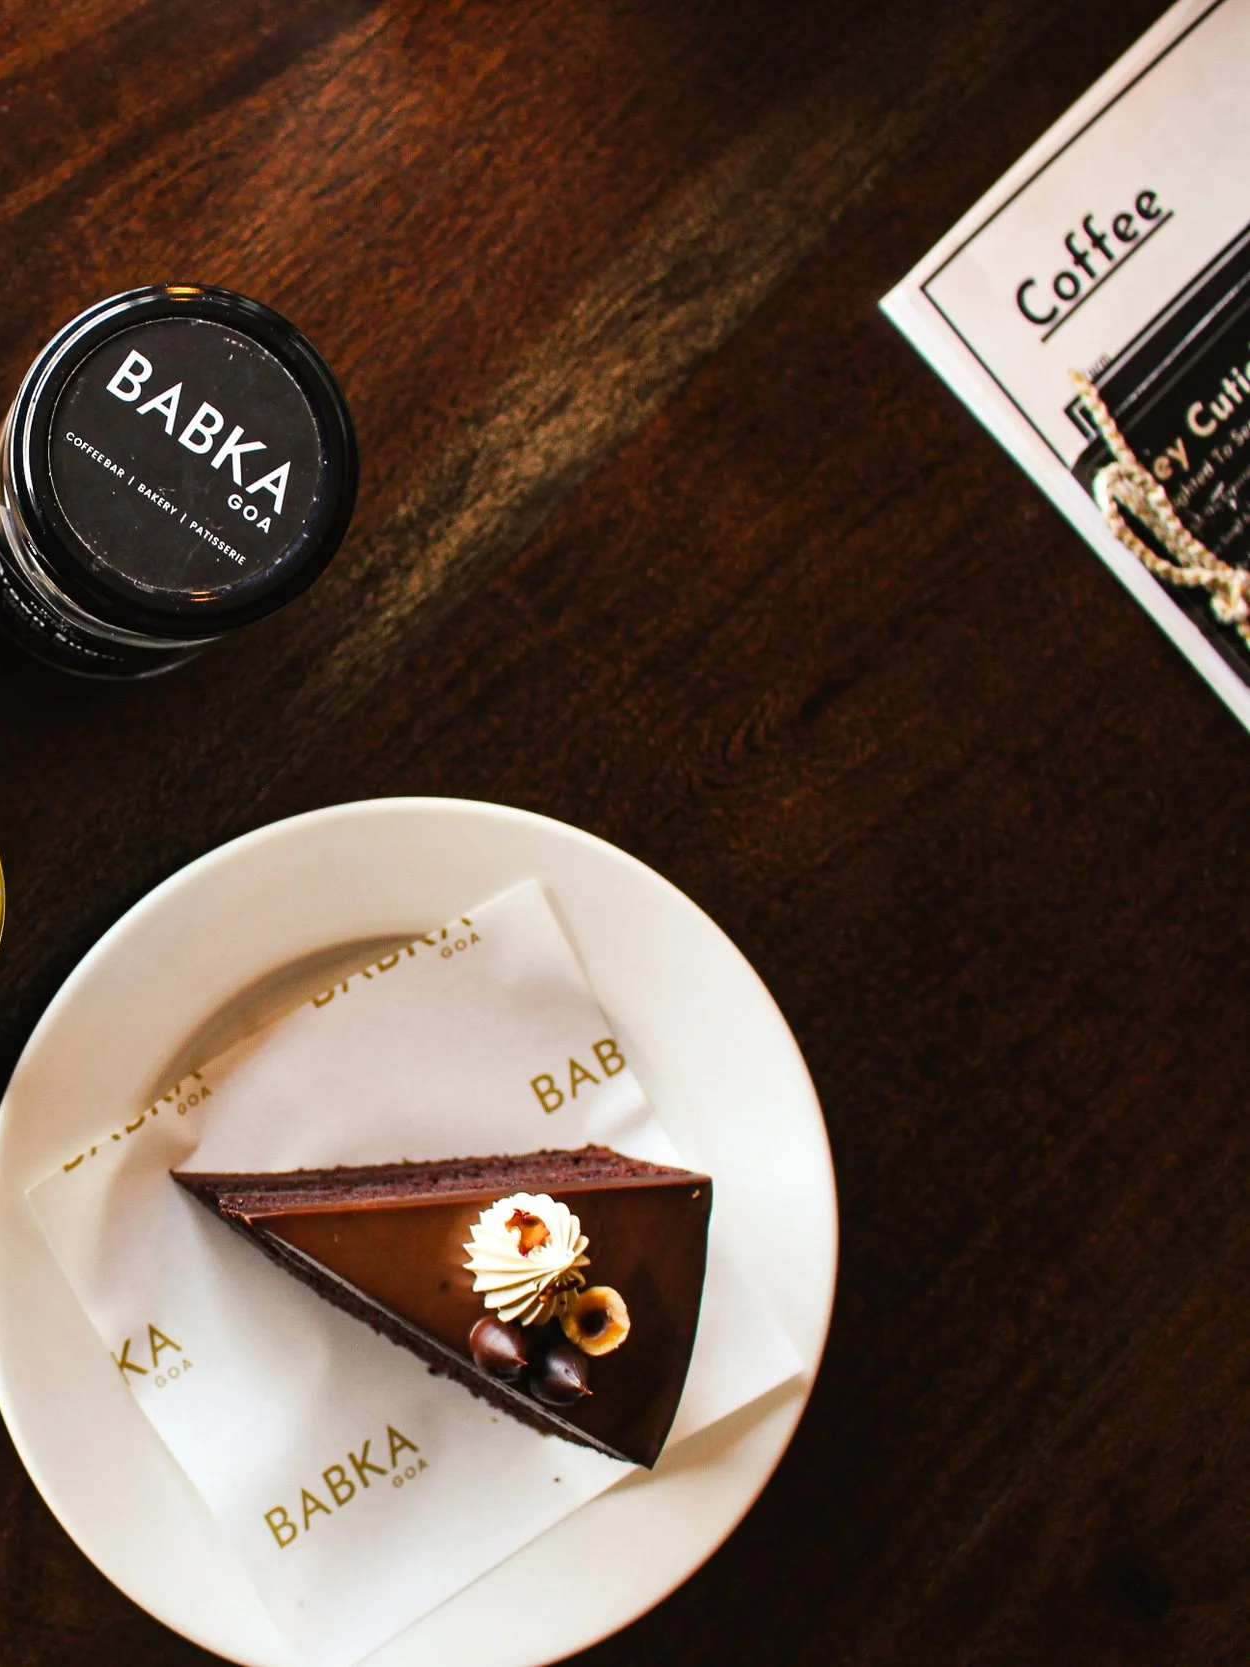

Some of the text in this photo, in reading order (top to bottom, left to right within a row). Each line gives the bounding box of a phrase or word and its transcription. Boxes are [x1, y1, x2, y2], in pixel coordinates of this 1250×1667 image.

[1015, 189, 1163, 328] Coffee
[105, 349, 291, 515] BABKA
[1153, 437, 1189, 480] ey
[1187, 360, 1250, 437] Cuti
[65, 431, 125, 479] COFFEEBAR
[137, 483, 179, 515] BAKERY
[189, 520, 247, 566] PATISSERIE
[227, 493, 272, 534] GOA
[440, 932, 481, 959] GOA
[177, 1085, 213, 1116] GOA
[531, 1039, 626, 1114] BAB
[154, 1358, 194, 1388] GOA
[263, 1424, 420, 1549] BABKA
[392, 1458, 430, 1488] GOA
